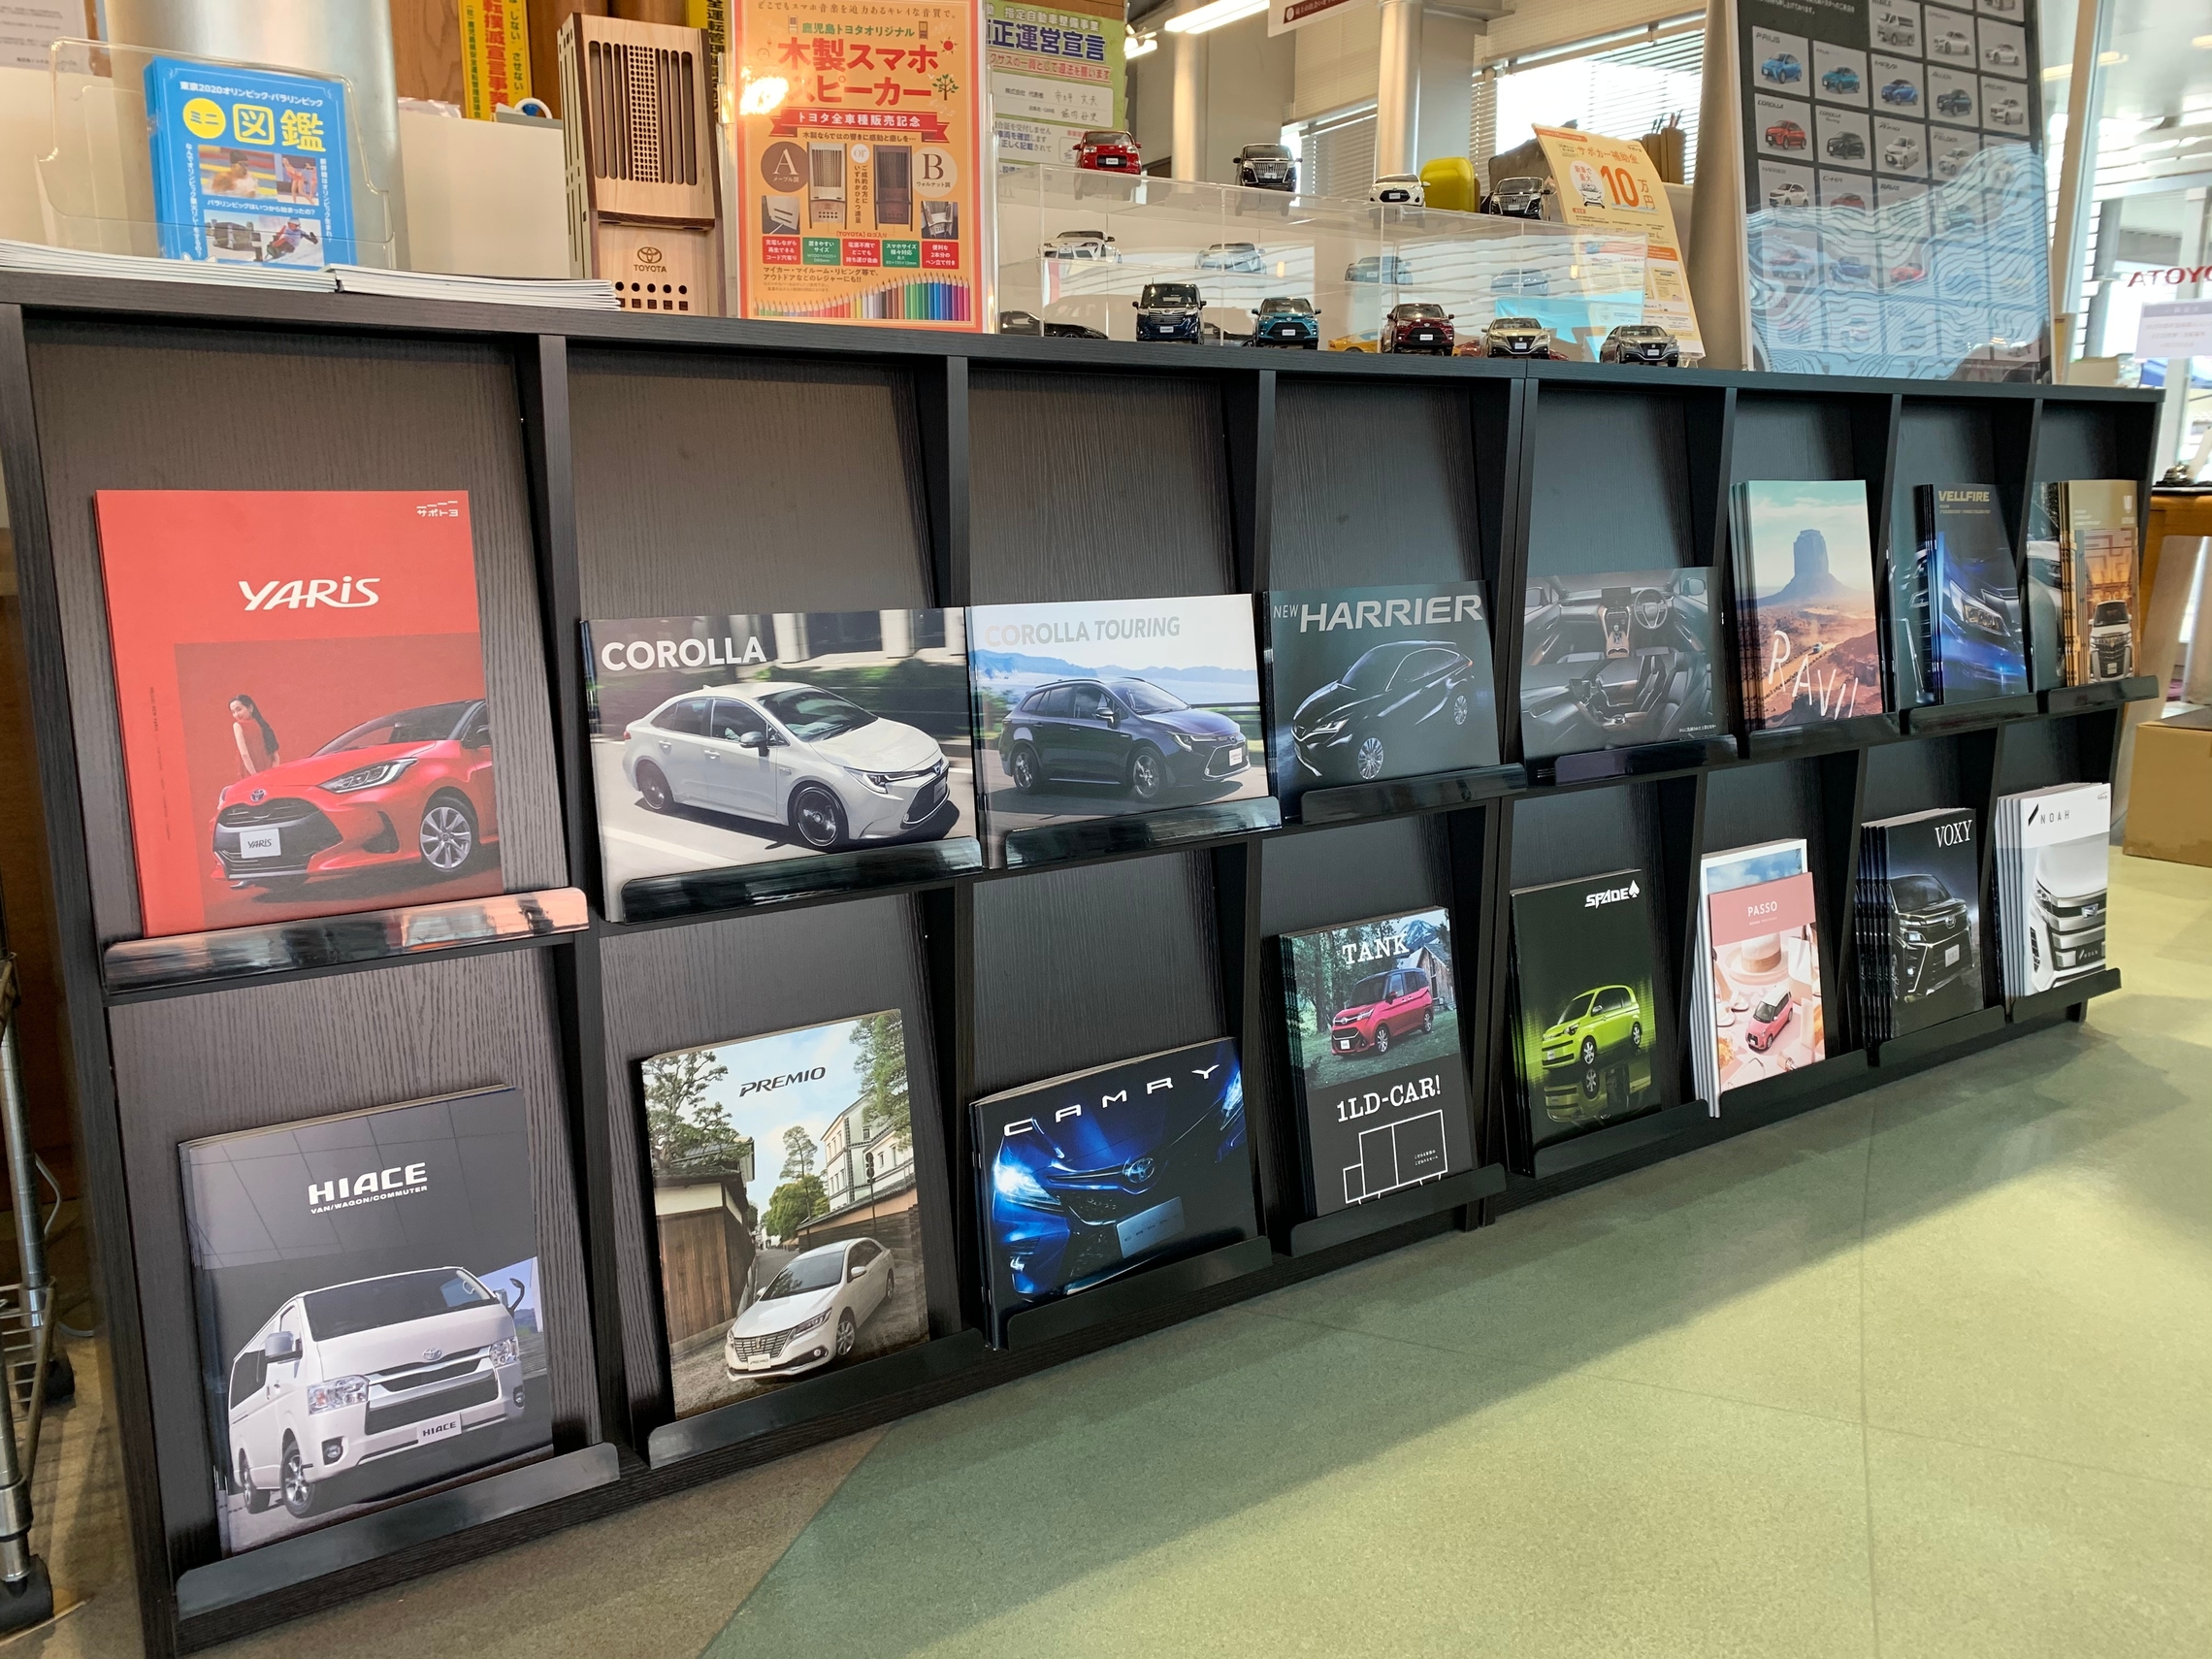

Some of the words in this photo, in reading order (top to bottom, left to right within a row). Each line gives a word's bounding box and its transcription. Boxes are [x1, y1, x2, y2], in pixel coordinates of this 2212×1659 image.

[802, 22, 915, 38] 鹿児島トヨタオリジナル
[987, 18, 1105, 61] 正運営宣言
[777, 37, 938, 74] 木製スマホ
[190, 111, 219, 125] ミニ
[232, 103, 326, 152] 図鑑
[798, 112, 921, 128] トヨタ全車種販売記念
[995, 120, 1052, 135] 合証を交付しません
[772, 148, 799, 176] A
[922, 153, 944, 180] B
[1600, 165, 1640, 208] 10
[634, 264, 667, 274] TOYOTA
[1937, 490, 1990, 503] VELLFIRE
[416, 507, 459, 517] サポトヨ
[1273, 603, 1299, 619] NEW
[1300, 594, 1483, 634] HARRIER
[985, 621, 1090, 647] COROLLA
[1094, 616, 1181, 640] TOURING
[601, 636, 767, 671] COROLLA
[2040, 810, 2070, 824] NOAH
[1935, 820, 1972, 848] VOXY
[1584, 887, 1630, 909] SPADE
[1747, 900, 1777, 917] PASSO
[1342, 933, 1411, 965] TANK
[739, 1066, 826, 1097] PREMIO
[1004, 1064, 1220, 1137] CAMRY
[1336, 1074, 1442, 1123] 1LD-CAR!
[308, 1161, 429, 1206] HIACE
[309, 1185, 429, 1215] VAN/WAGON/COMMUTER
[422, 1420, 457, 1437] HIACE
